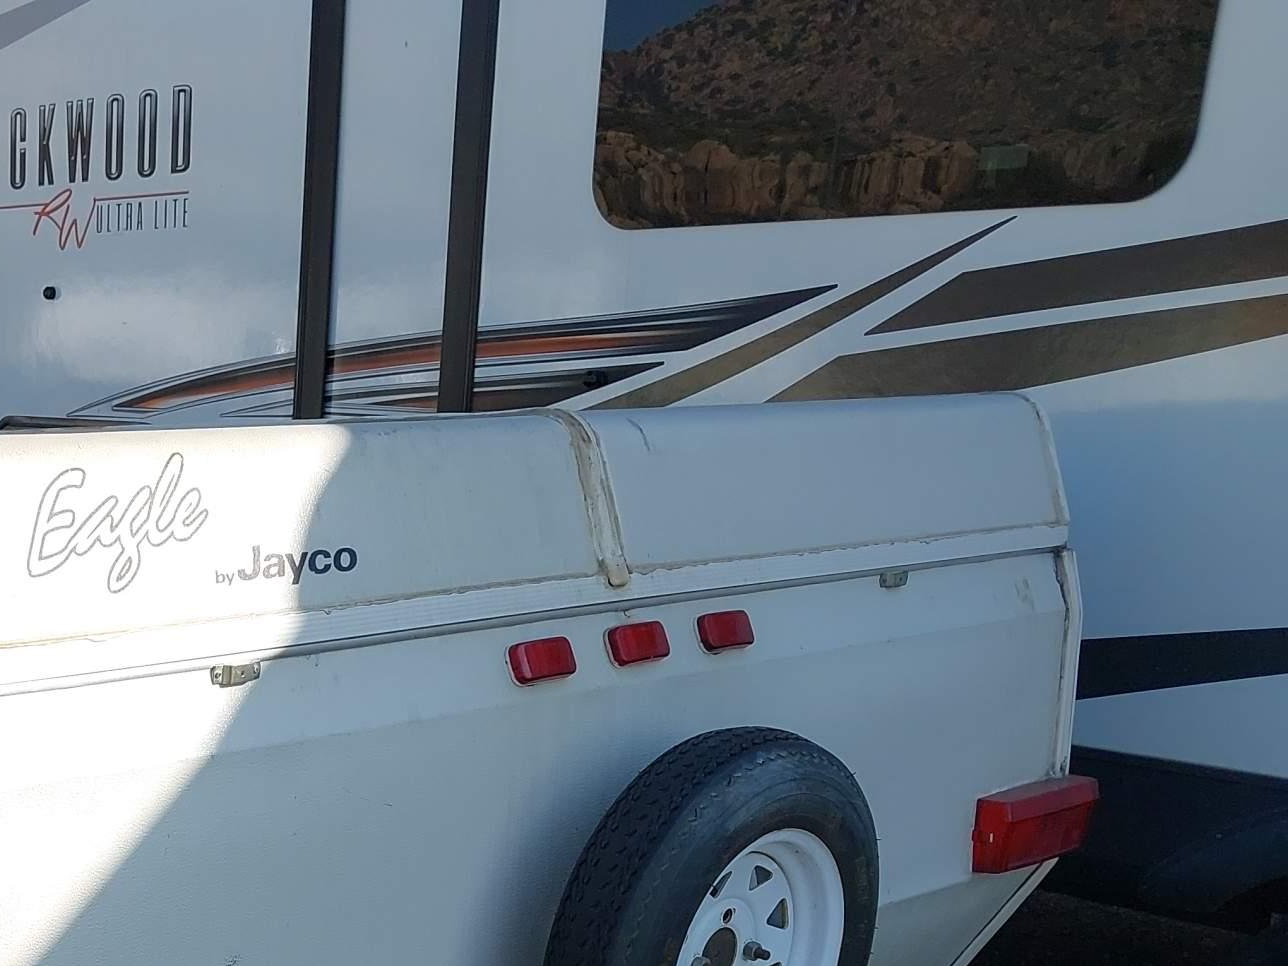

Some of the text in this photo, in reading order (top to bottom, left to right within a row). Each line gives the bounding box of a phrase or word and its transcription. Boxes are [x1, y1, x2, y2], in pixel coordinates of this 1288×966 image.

[96, 202, 143, 234] ULTRA
[154, 198, 189, 230] LITE
[27, 452, 209, 593] Eagle
[215, 545, 358, 586] by Jayco
